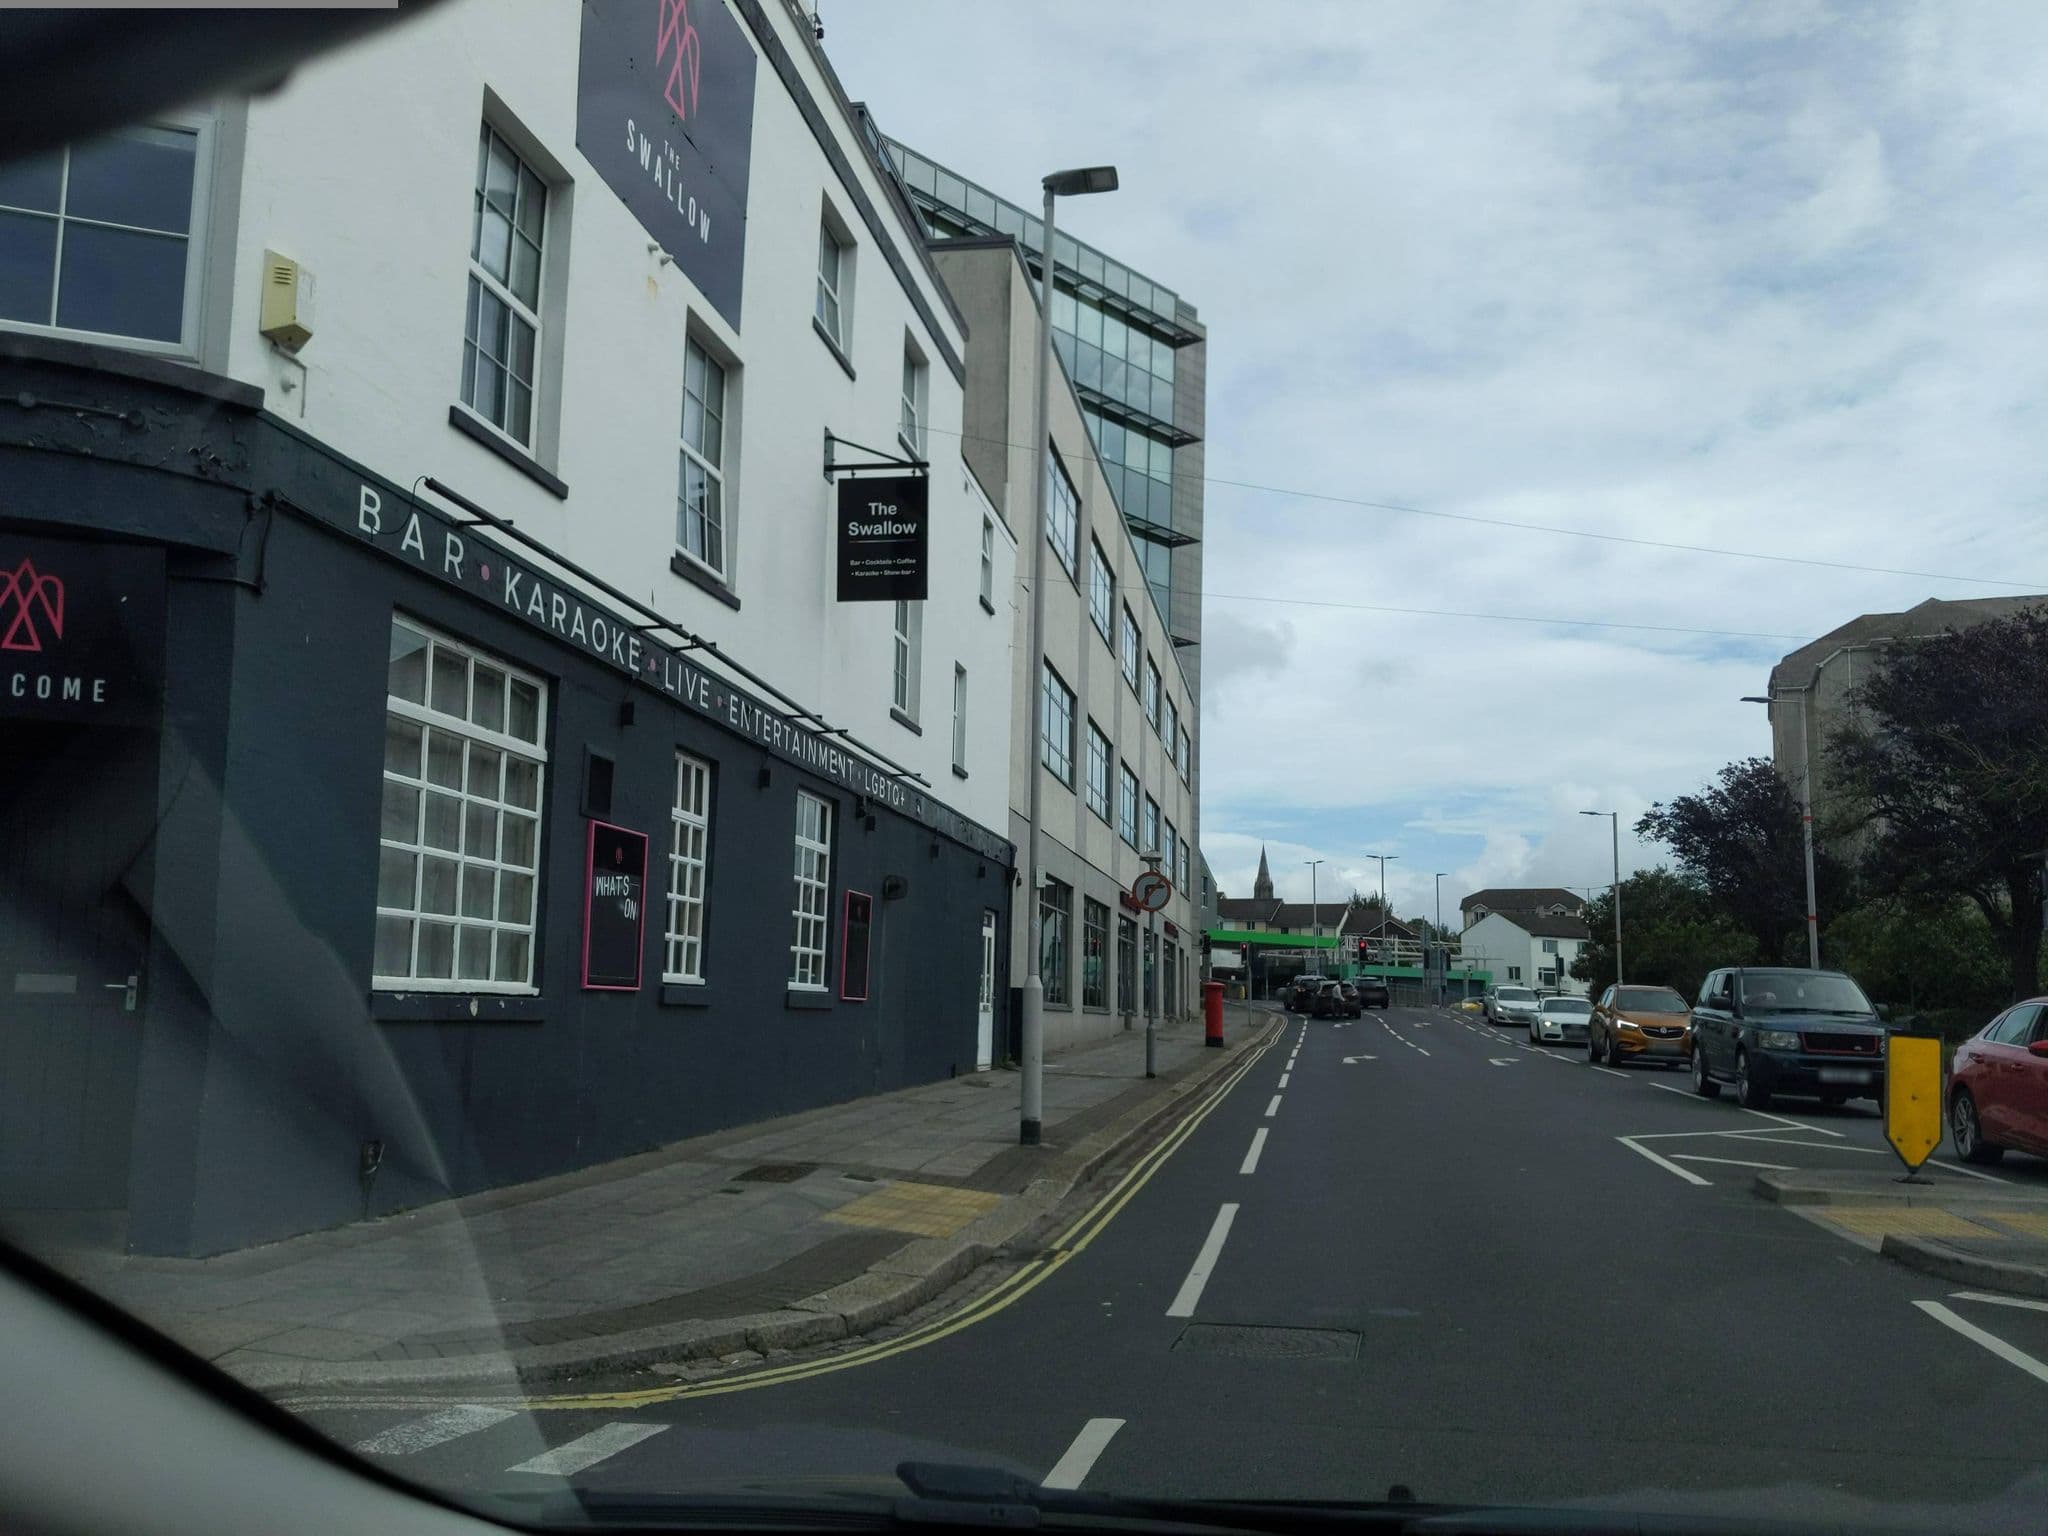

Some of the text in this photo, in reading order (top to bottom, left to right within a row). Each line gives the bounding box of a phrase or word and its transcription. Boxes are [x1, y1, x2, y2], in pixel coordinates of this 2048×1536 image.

[664, 140, 681, 171] THE
[626, 118, 710, 244] SWALLOW
[868, 502, 898, 516] The
[848, 520, 917, 536] Swallow
[358, 484, 464, 580] BAR
[504, 566, 641, 673] KARAOKE
[664, 657, 710, 710] LIVE
[728, 694, 854, 782] ENTERTAINMENT
[624, 898, 637, 921] ON
